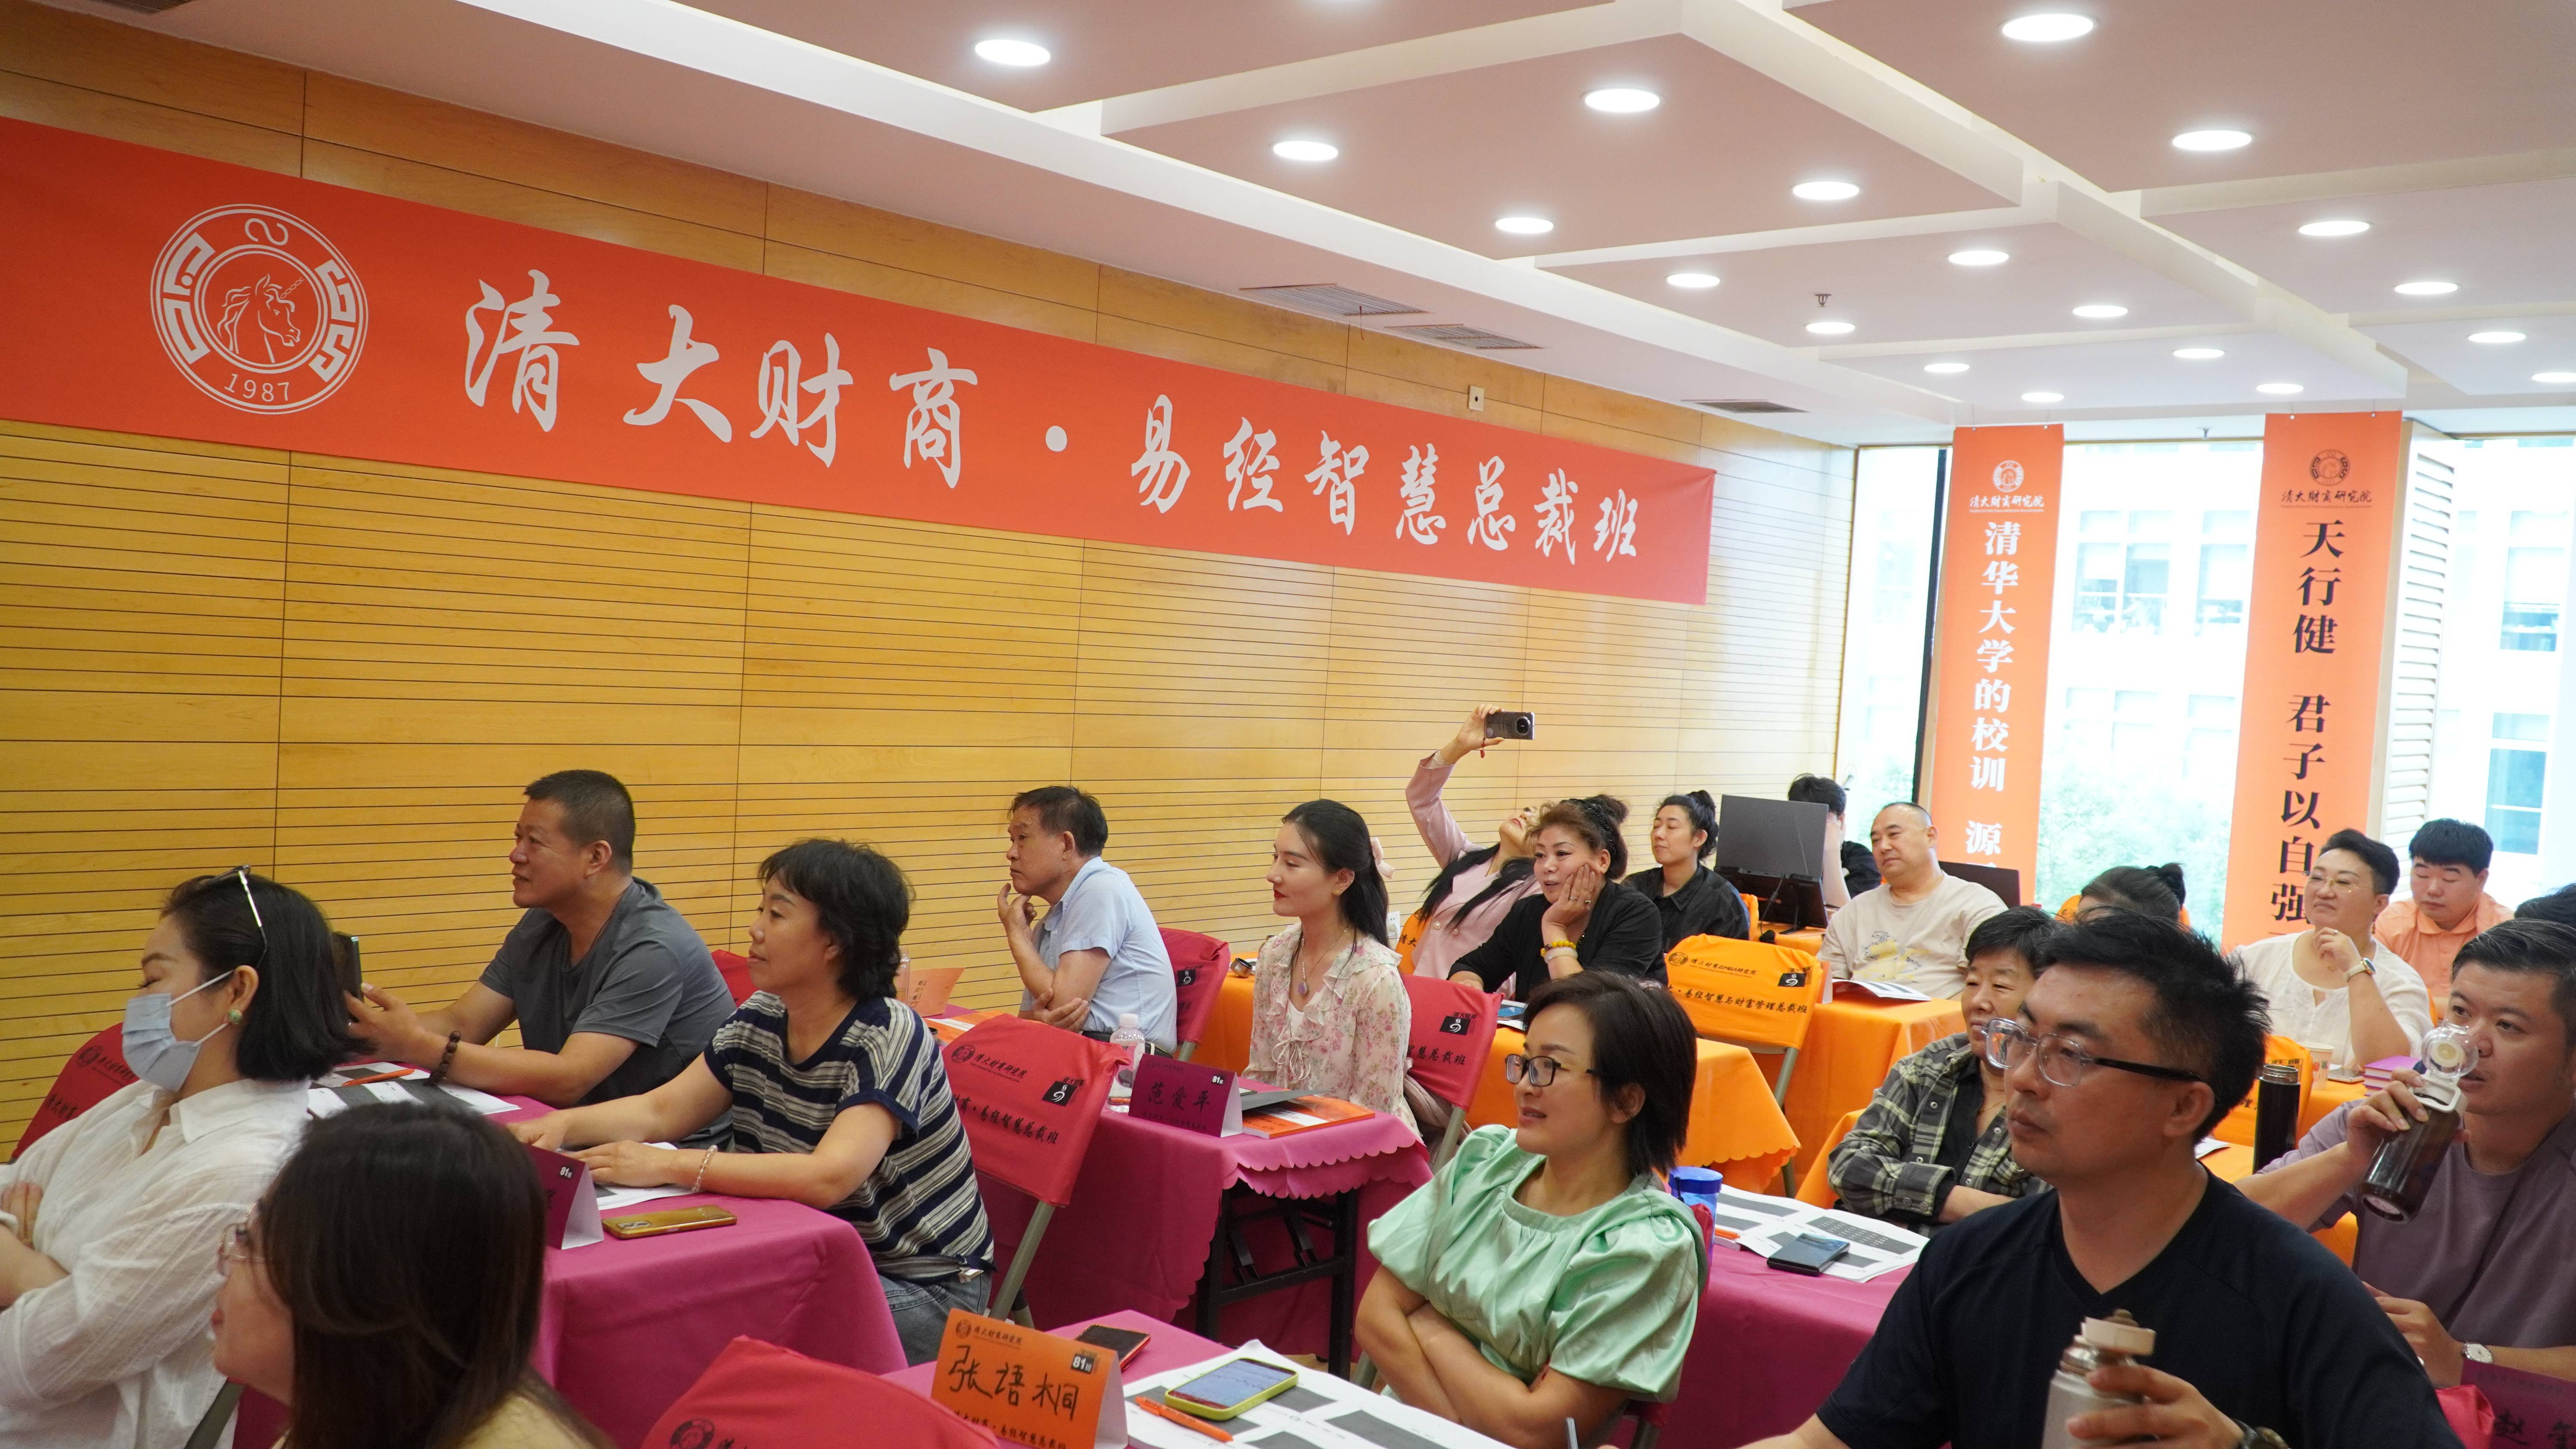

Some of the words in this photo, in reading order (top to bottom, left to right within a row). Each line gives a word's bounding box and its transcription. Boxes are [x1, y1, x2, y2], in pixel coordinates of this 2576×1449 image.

[224, 373, 290, 402] 1987
[1969, 495, 2044, 508] 清大财商研究院
[2281, 489, 2372, 503] 清大财商研究院
[2292, 519, 2345, 654] 天行健
[1969, 521, 2021, 792] 清华大学的校训
[2268, 694, 2332, 935] 君子以自强
[1965, 820, 2003, 867] 源
